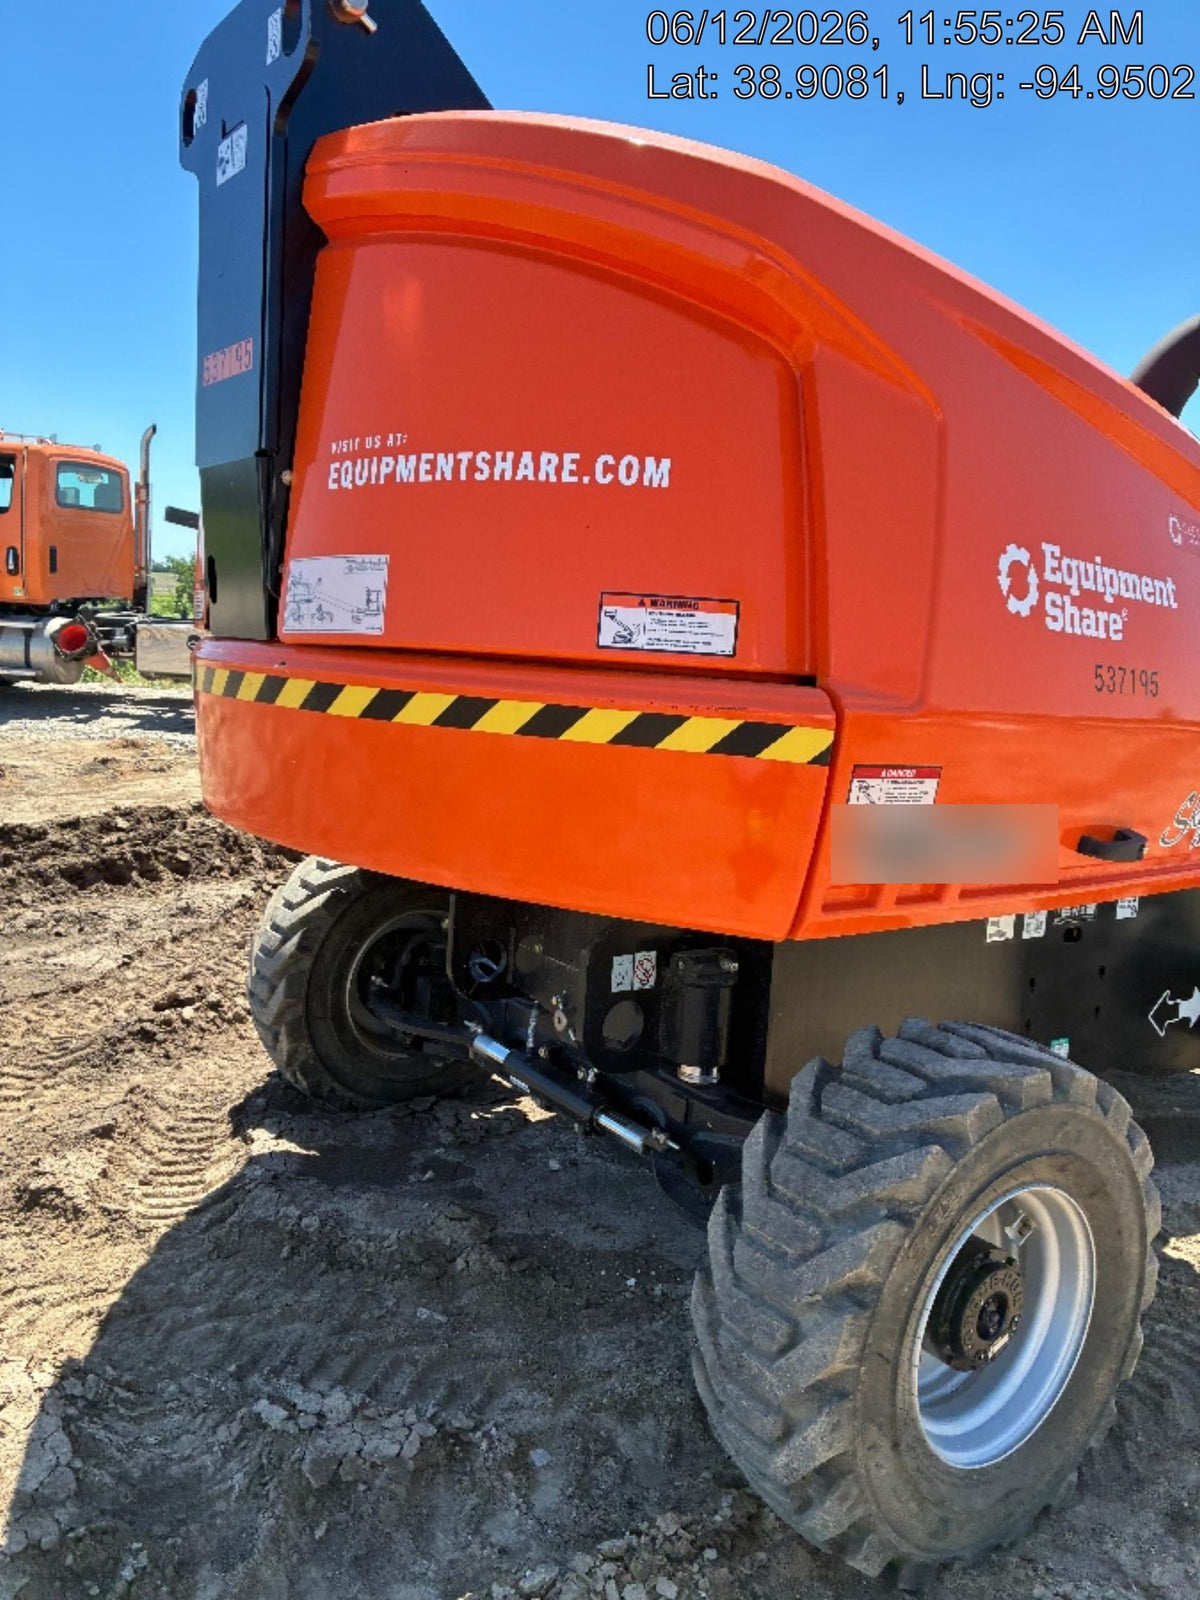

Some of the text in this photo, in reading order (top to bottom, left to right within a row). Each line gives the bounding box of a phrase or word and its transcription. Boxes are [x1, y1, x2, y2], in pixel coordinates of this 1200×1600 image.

[365, 434, 382, 449] US
[387, 432, 408, 447] AT:
[328, 451, 671, 490] EQUIPMENTSHARE.COM
[1041, 541, 1178, 609] Equipment
[650, 599, 700, 610] WARNING
[1045, 591, 1123, 641] Share
[1094, 664, 1159, 698] 537195
